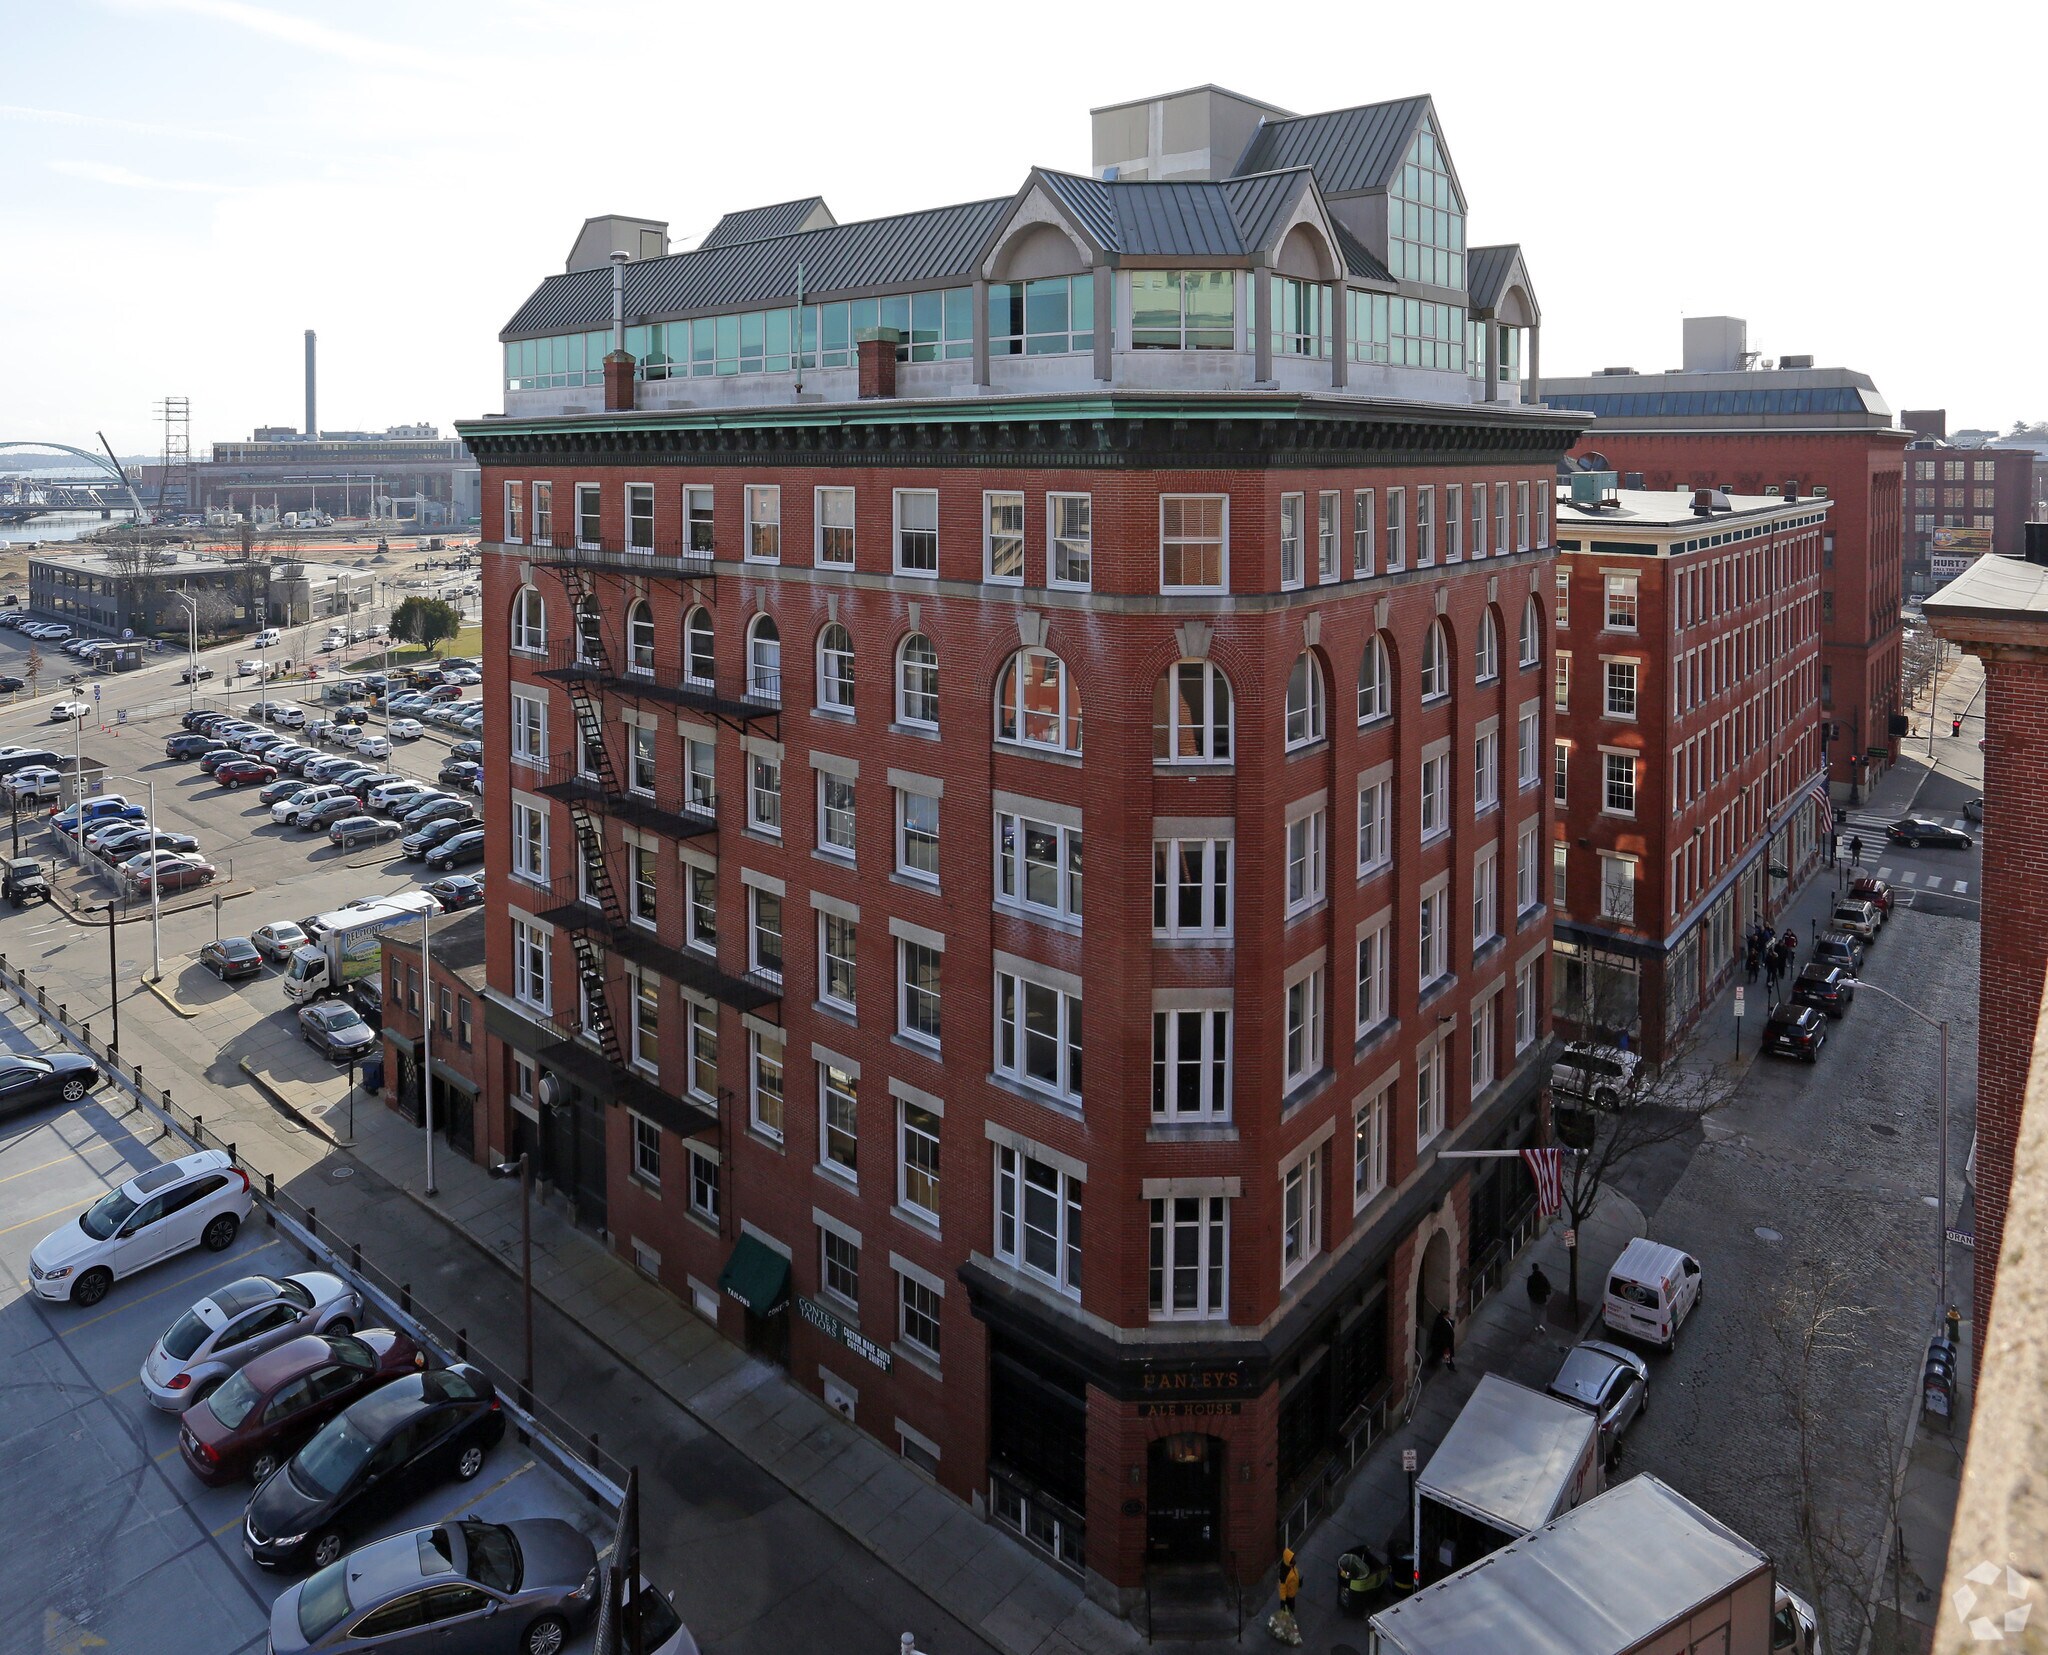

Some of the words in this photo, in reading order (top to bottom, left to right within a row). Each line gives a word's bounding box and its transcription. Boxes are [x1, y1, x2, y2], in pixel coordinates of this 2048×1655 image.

[1933, 559, 1968, 568] HURT?
[346, 923, 383, 948] BELMONT
[1948, 1232, 1975, 1245] ORAN
[727, 1286, 751, 1308] TAILORS
[798, 1297, 838, 1328] CONTE'S
[800, 1308, 837, 1338] TAILORS
[843, 1326, 862, 1345] CUSTOM
[862, 1338, 876, 1354] MADE
[846, 1338, 867, 1358] CUSTOM
[1148, 1405, 1176, 1416] ALE
[1184, 1403, 1233, 1416] HOUSE
